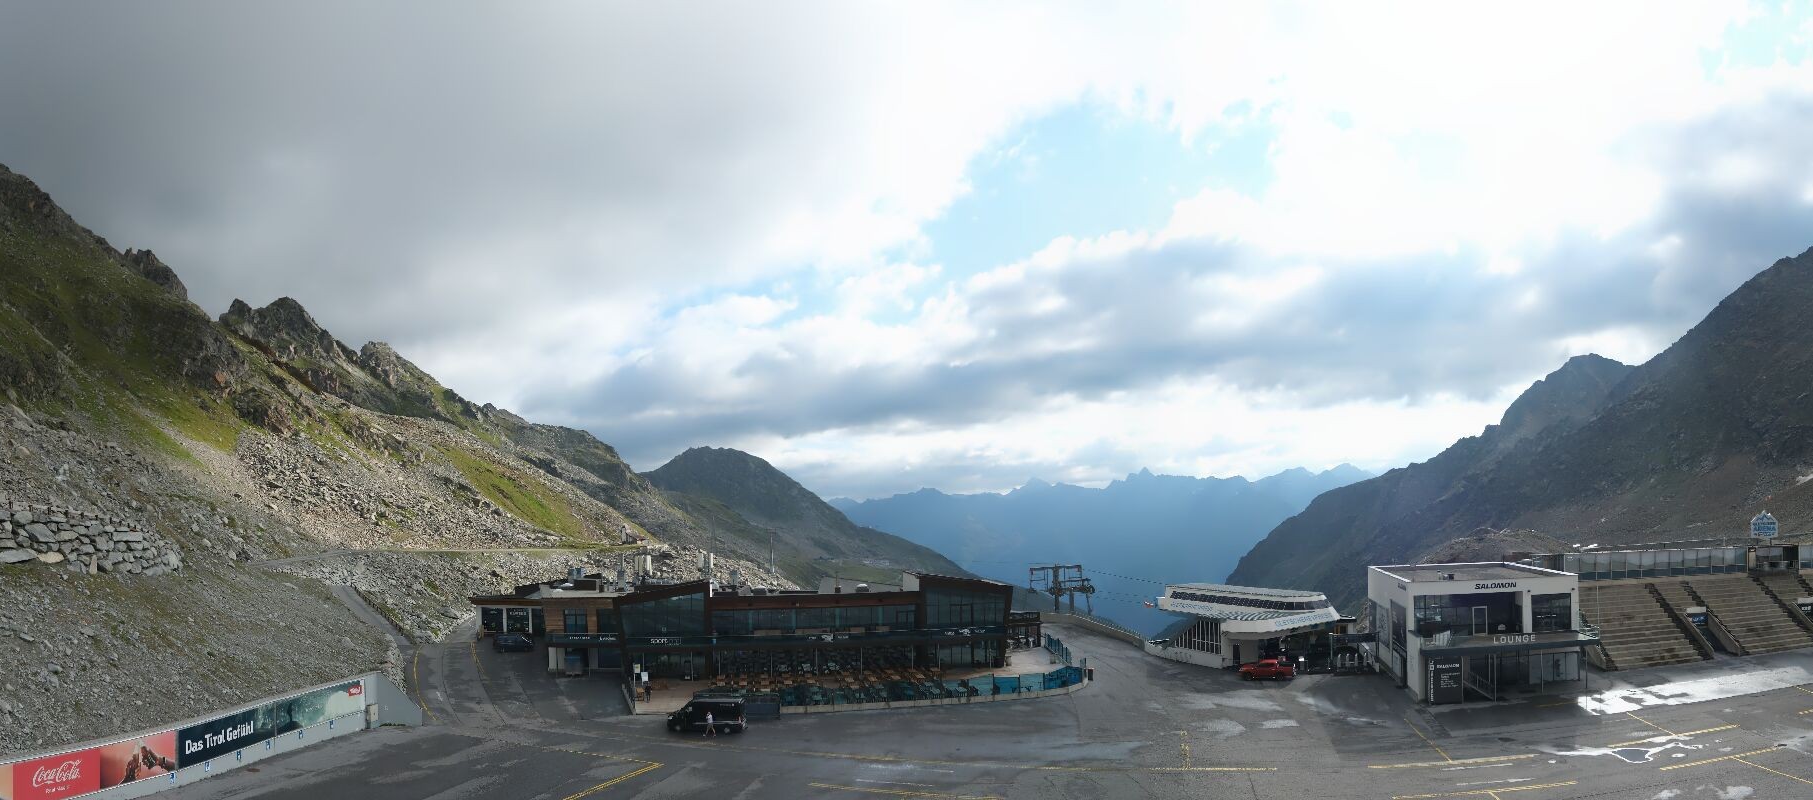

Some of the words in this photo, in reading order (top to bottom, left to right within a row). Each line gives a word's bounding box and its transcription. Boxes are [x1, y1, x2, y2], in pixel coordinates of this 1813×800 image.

[1474, 582, 1517, 590] SALOMON
[1493, 634, 1536, 644] LOUNGE
[185, 739, 204, 755] Das
[204, 729, 226, 749] Tirol
[226, 720, 254, 742] Gefühl
